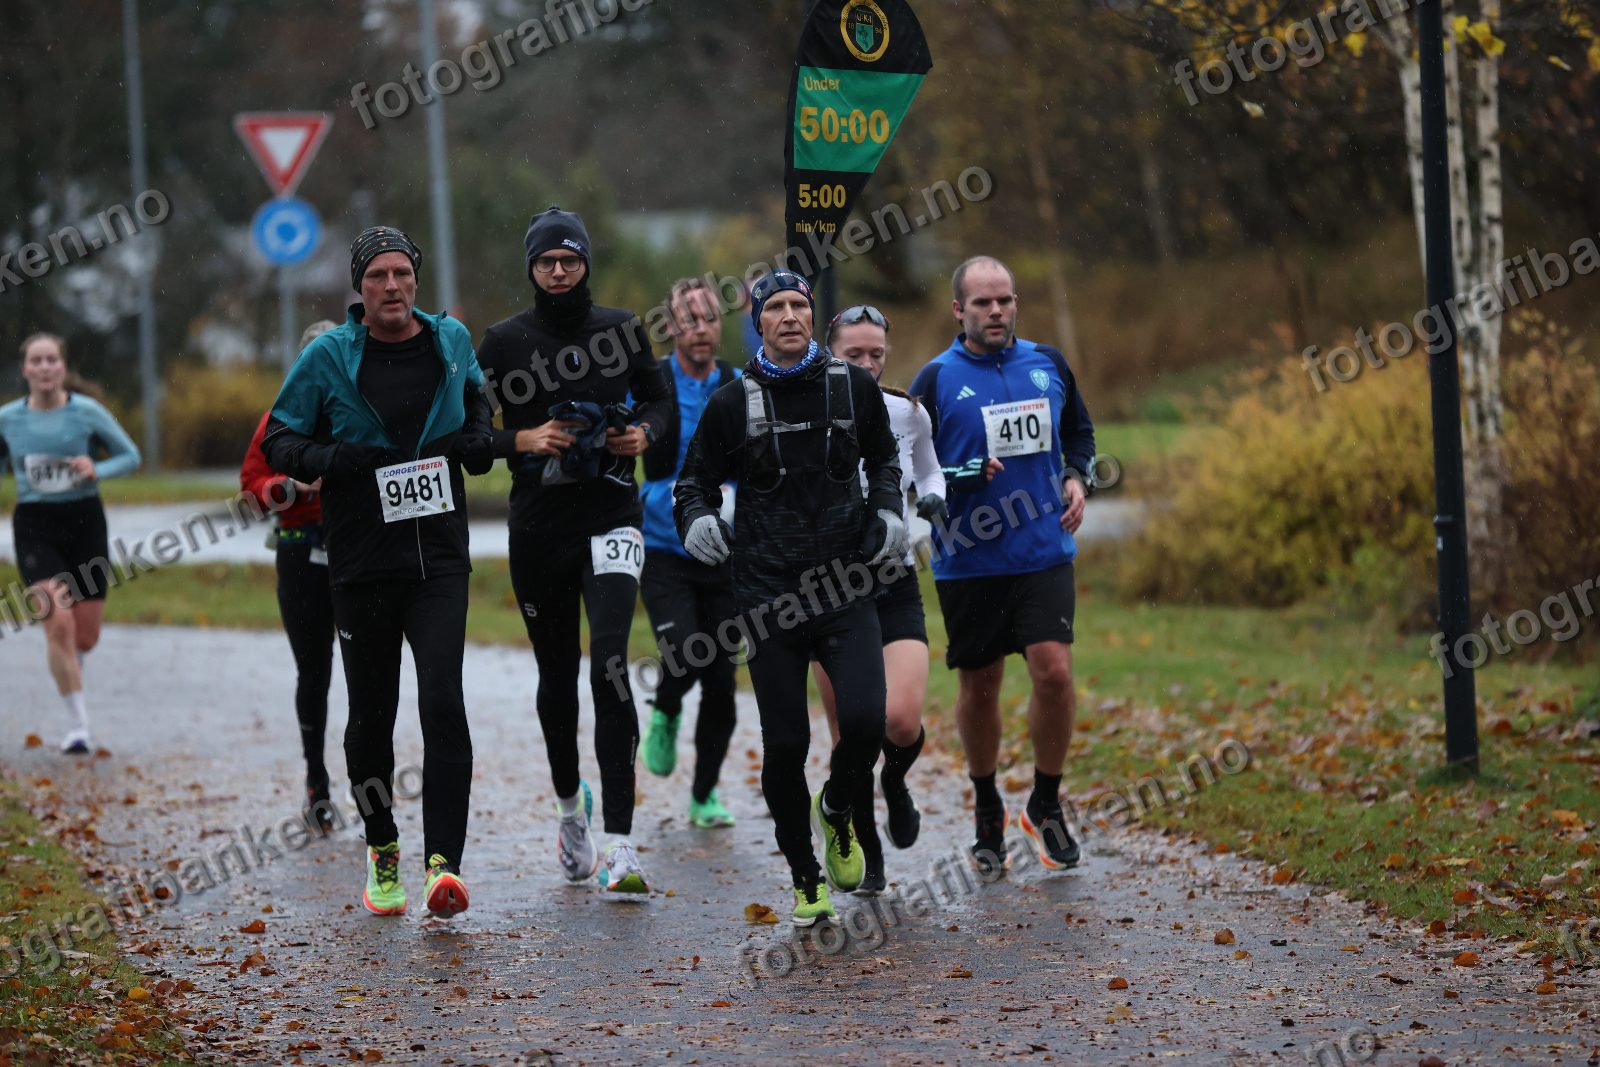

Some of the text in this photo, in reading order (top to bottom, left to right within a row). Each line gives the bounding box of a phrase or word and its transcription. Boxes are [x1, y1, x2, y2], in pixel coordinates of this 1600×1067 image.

[804, 76, 840, 91] Under
[800, 106, 890, 144] 50:00
[798, 183, 846, 208] 5:00
[1000, 413, 1041, 443] 410
[385, 472, 444, 507] 9481
[606, 538, 641, 568] 370
